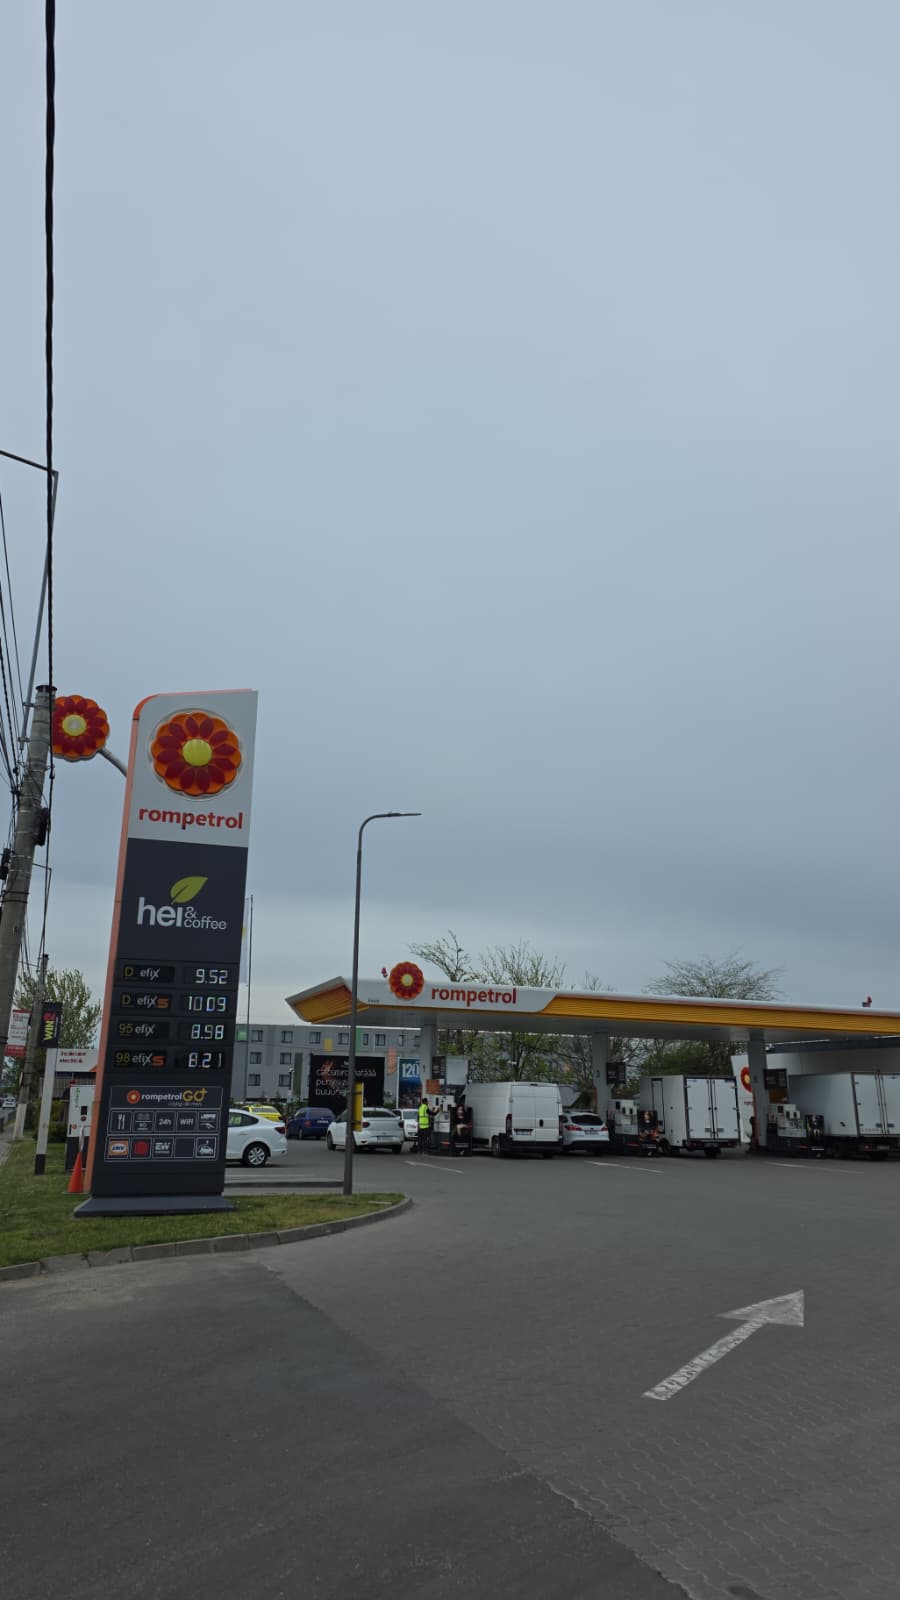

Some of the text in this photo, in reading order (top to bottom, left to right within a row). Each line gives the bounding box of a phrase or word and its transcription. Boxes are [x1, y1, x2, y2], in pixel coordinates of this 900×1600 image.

[138, 808, 243, 830] rompetrol
[136, 896, 183, 928] hei
[184, 916, 227, 931] coffee
[124, 966, 134, 977] D
[121, 994, 131, 1005] D
[432, 988, 517, 1007] rompetrol
